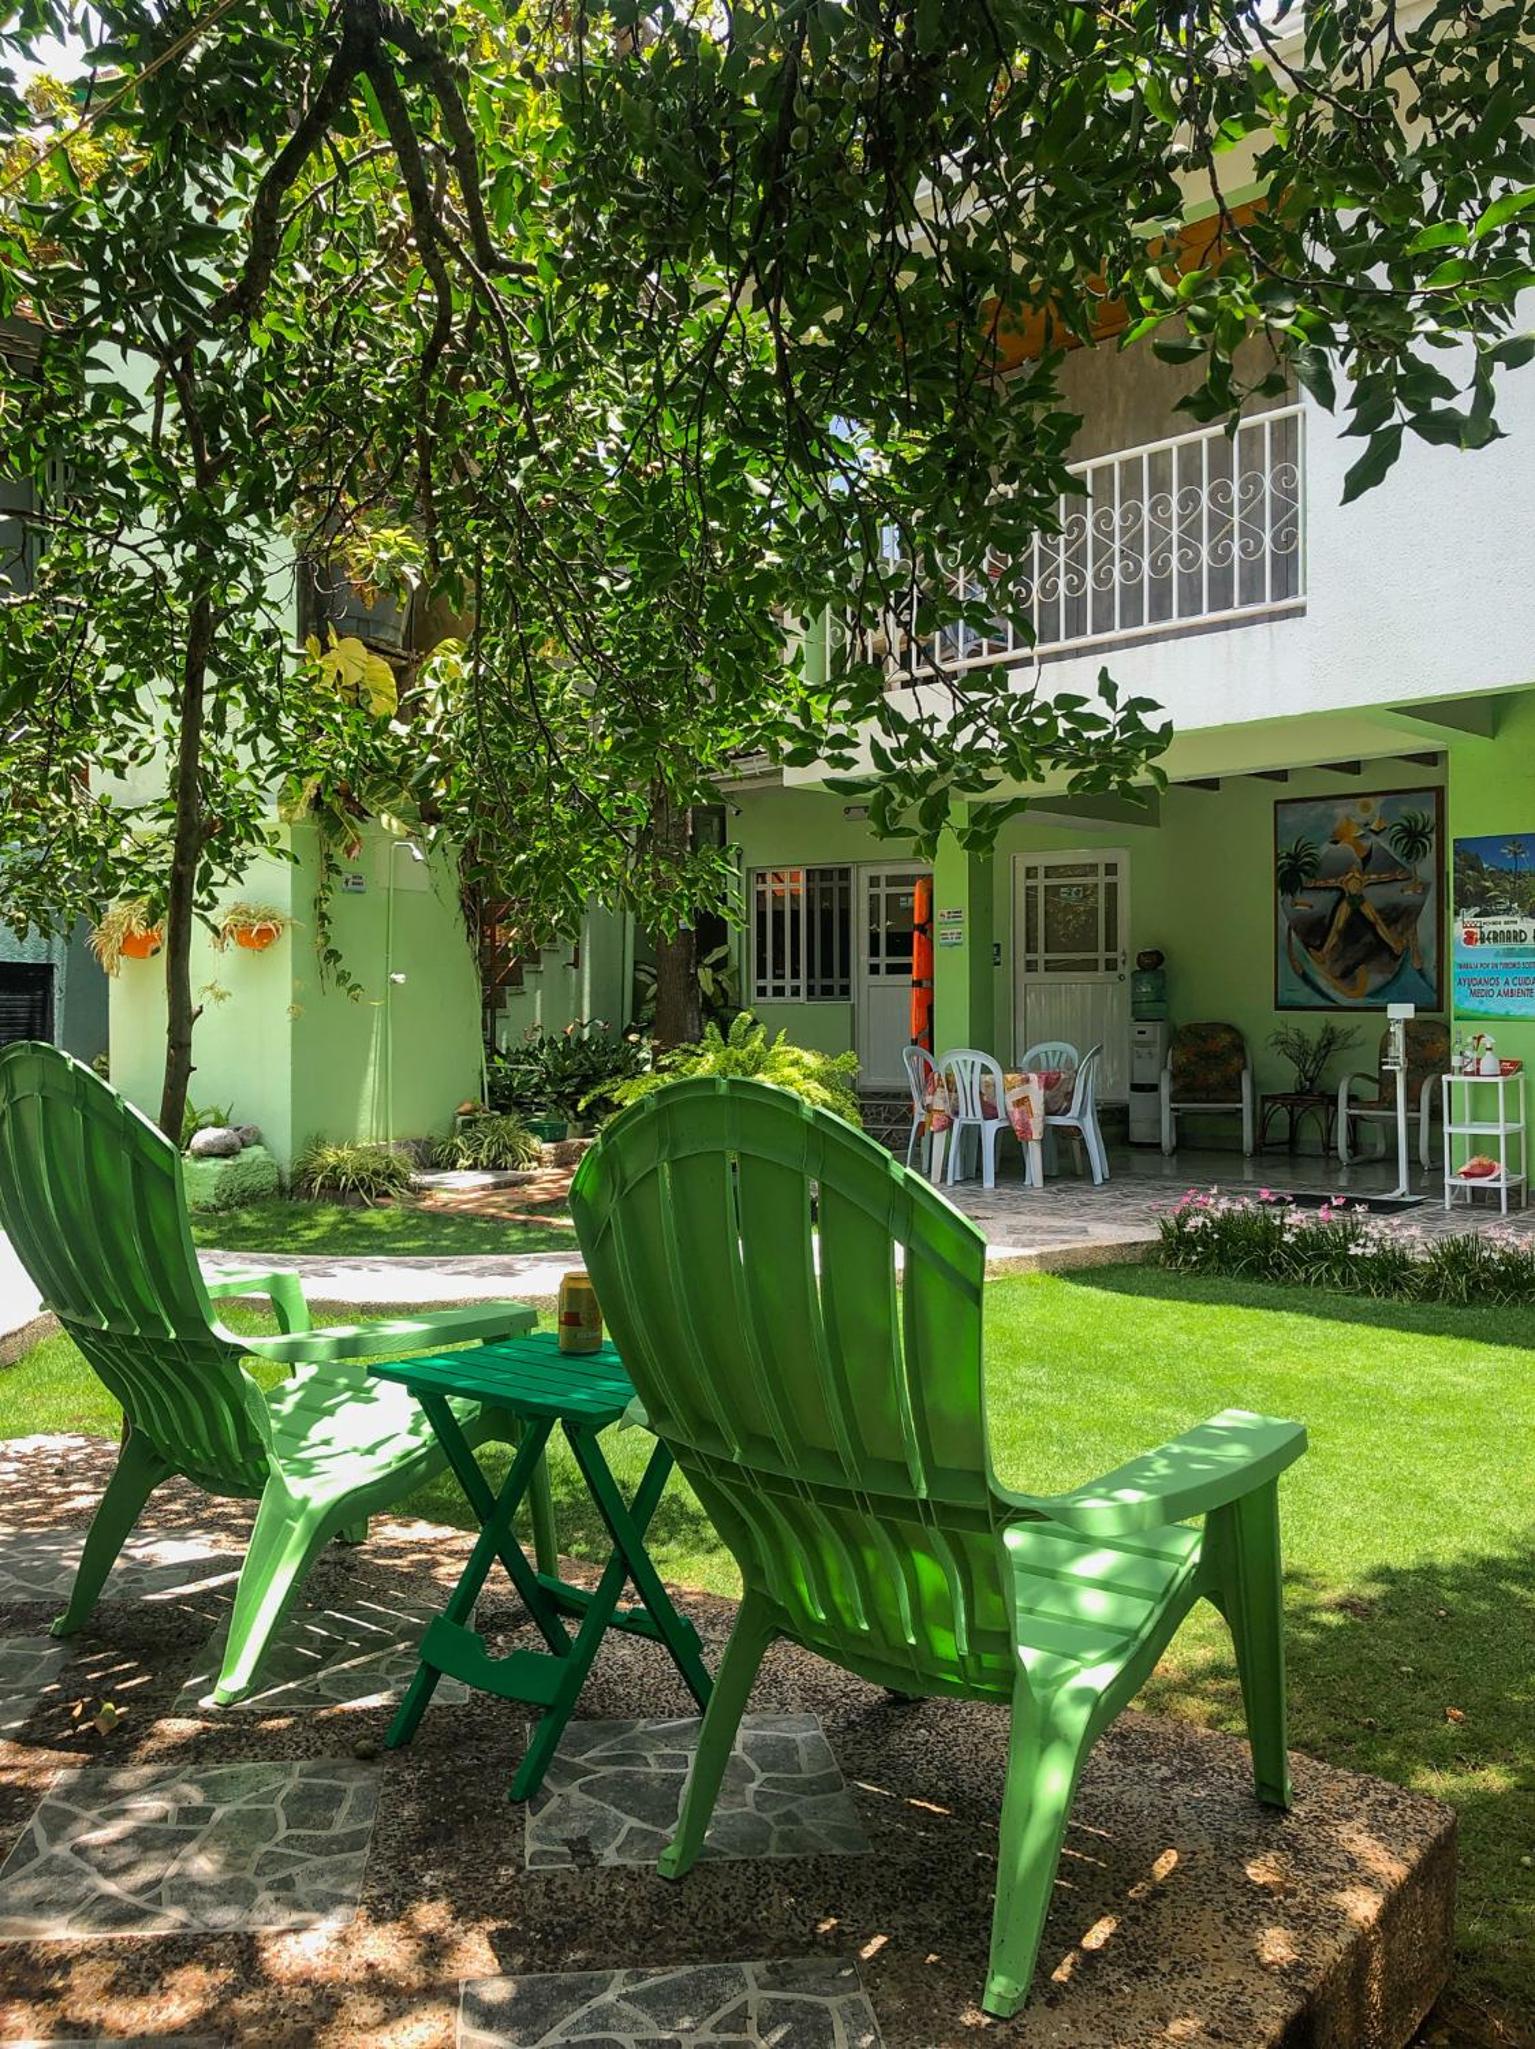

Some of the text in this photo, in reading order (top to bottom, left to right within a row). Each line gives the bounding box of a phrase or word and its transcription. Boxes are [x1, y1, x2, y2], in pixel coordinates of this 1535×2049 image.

[1479, 928, 1528, 944] BERNARD
[1503, 977, 1510, 986] A
[1469, 988, 1534, 997] MEDIO AMBIENTE
